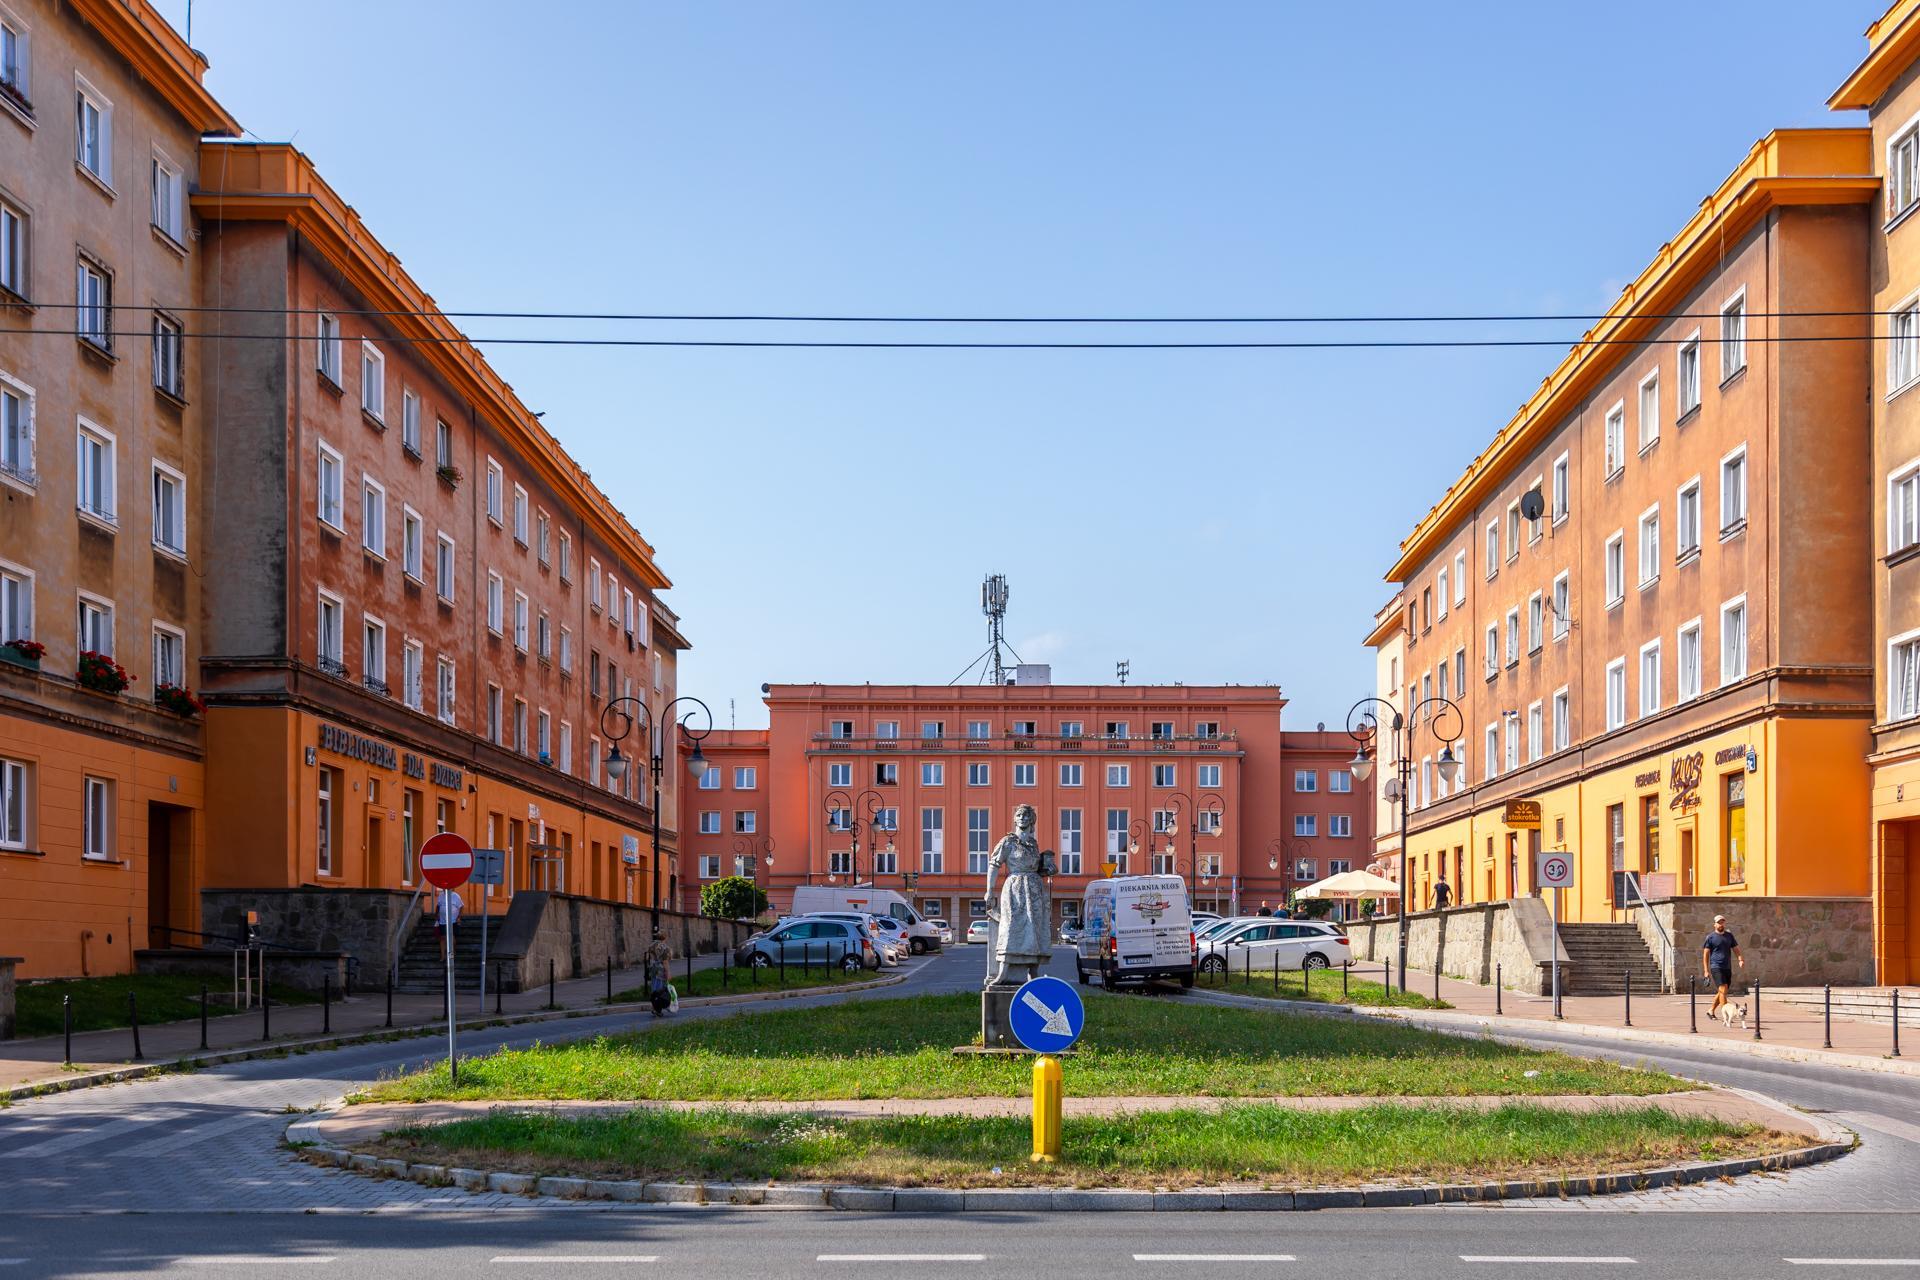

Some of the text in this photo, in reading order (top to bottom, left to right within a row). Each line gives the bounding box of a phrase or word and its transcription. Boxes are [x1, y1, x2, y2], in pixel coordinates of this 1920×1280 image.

[321, 723, 398, 770] BIBLIOTEKA
[404, 753, 425, 780] DLA
[433, 763, 462, 791] DZIECI
[1548, 864, 1565, 877] 30
[1120, 884, 1159, 892] PIEKARNIA
